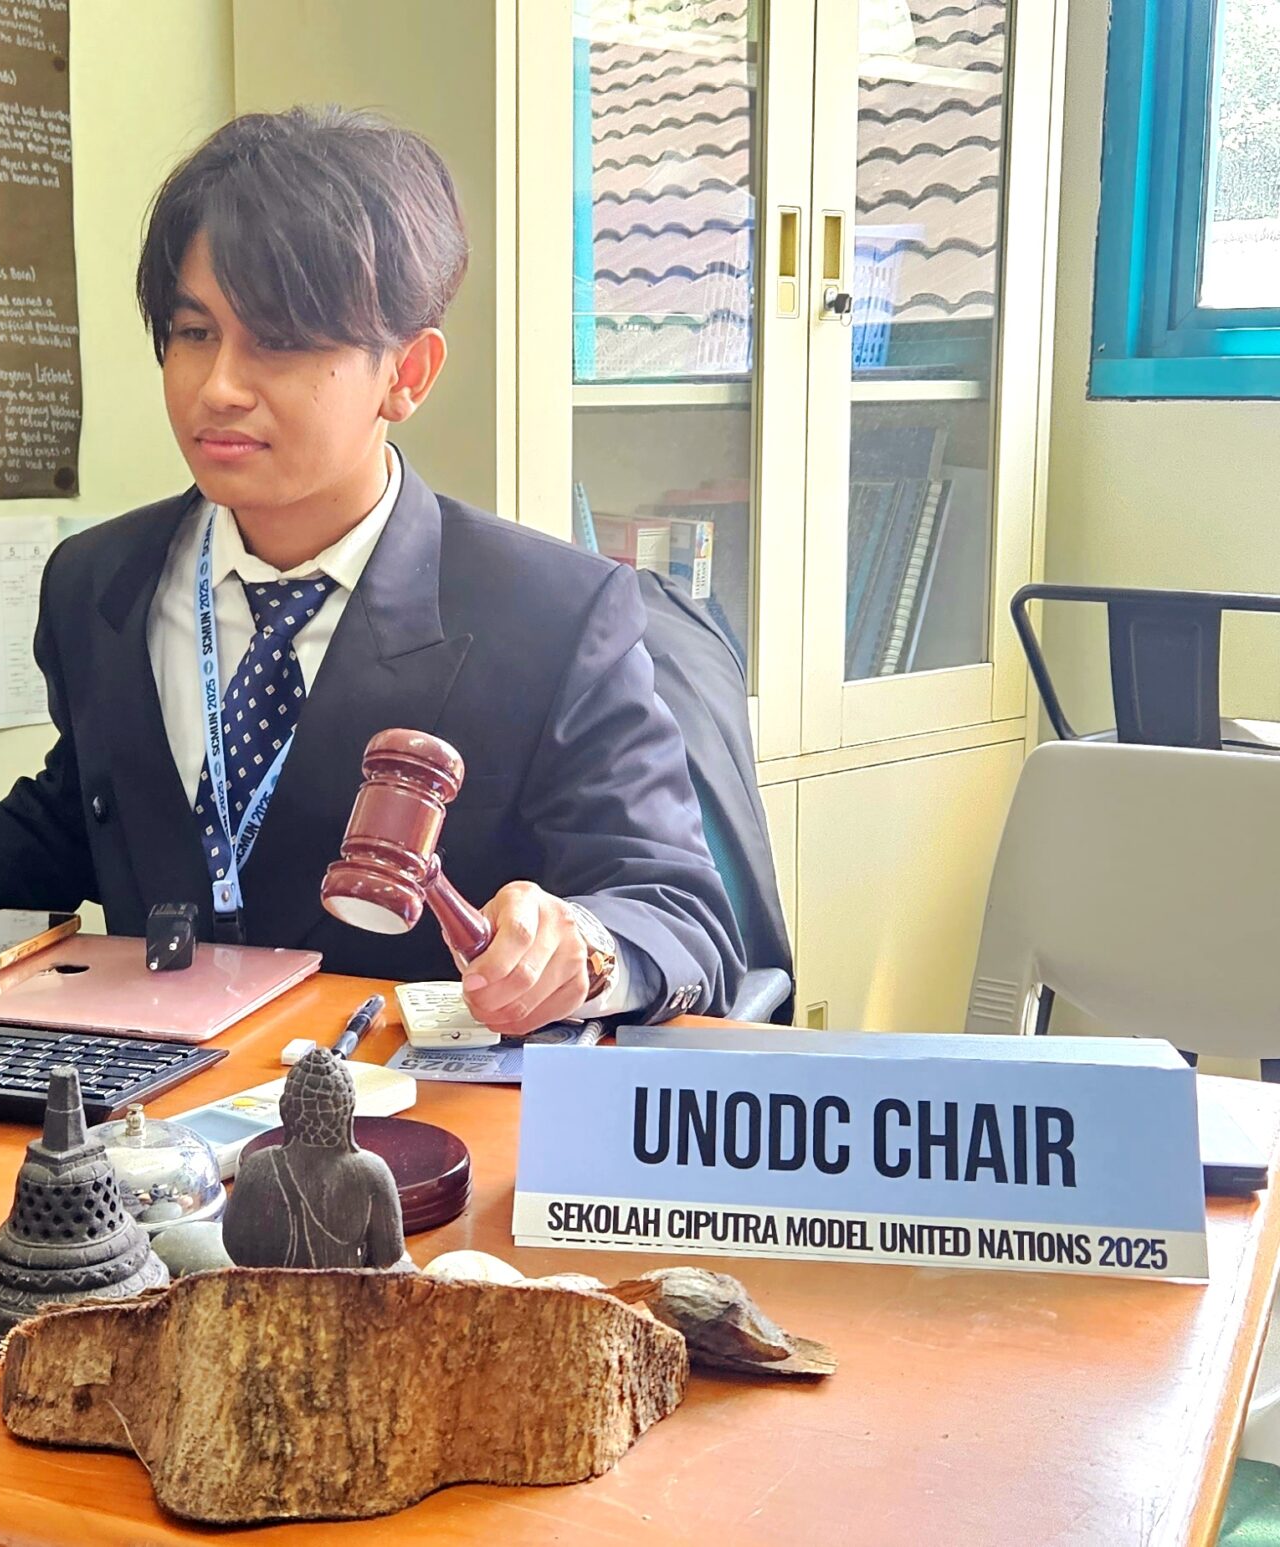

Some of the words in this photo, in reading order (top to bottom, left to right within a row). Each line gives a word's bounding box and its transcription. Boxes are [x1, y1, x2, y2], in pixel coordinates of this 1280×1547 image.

[9, 546, 15, 557] 5
[200, 578, 210, 612] 2025
[200, 611, 214, 657] SCMUN
[206, 679, 218, 711] 2025
[208, 711, 221, 758] SCMUN
[398, 1059, 489, 1073] 2025
[631, 1086, 852, 1175] UNODC
[872, 1096, 1076, 1188] CHAIR
[547, 1201, 661, 1238] SEKOLAH
[666, 1207, 778, 1246] CIPUTRA
[785, 1216, 874, 1252] MODEL
[878, 1222, 971, 1258] UNITED
[977, 1231, 1091, 1267] NATIONS
[1097, 1237, 1169, 1272] 2025
